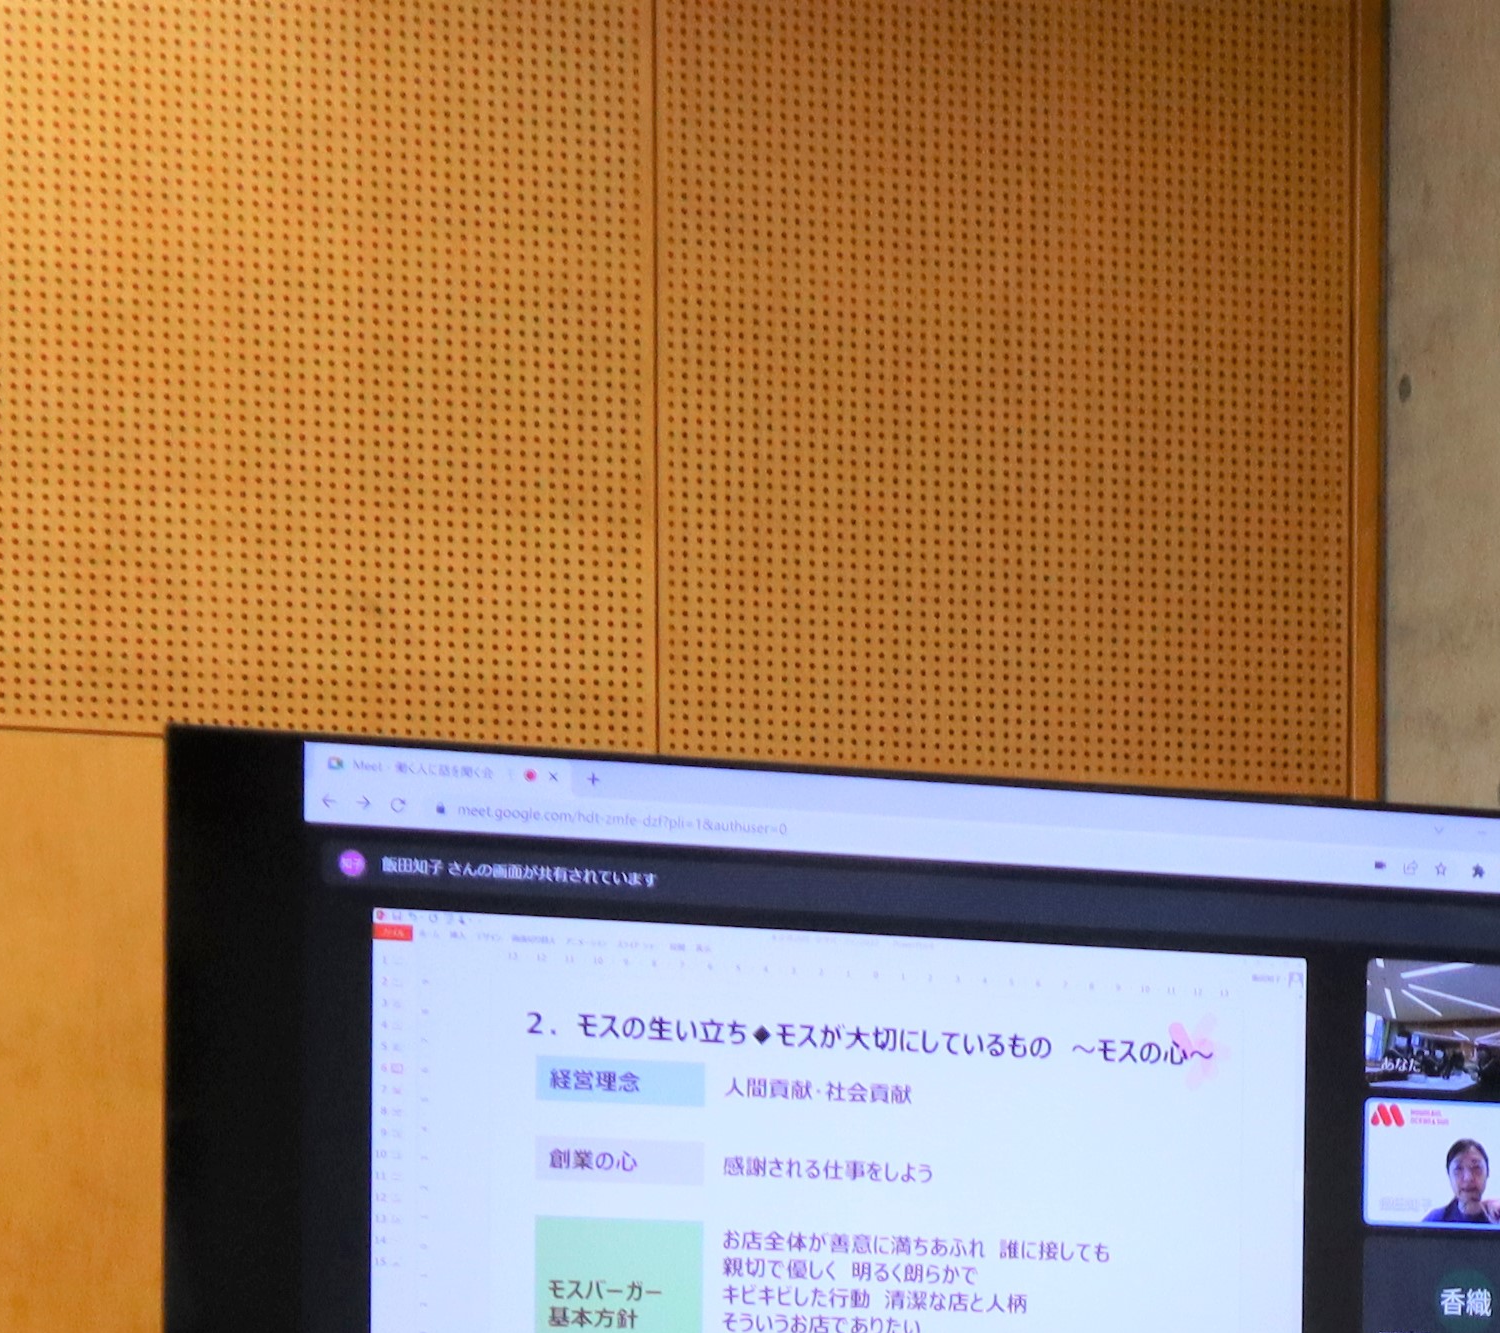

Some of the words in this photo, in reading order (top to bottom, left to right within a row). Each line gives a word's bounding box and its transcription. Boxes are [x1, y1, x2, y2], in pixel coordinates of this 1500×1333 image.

[381, 856, 443, 876] 飯田知子
[550, 1067, 640, 1093] 経営理念
[549, 1148, 638, 1172] 創業の心
[723, 1155, 933, 1183] 感謝される仕事をしよう
[722, 1230, 986, 1259] お店全体が善意に満ちあふれ
[1000, 1238, 1111, 1263] 誰に接しても
[722, 1256, 837, 1281] 親切で優しく
[852, 1261, 978, 1286] 明るく朗らかで
[548, 1279, 662, 1302] モスバーガー
[722, 1285, 870, 1310] キビキビした行動
[885, 1289, 1028, 1315] 清潔な店と人柄
[1440, 1288, 1492, 1317] 香織
[548, 1306, 638, 1330] 基本方針
